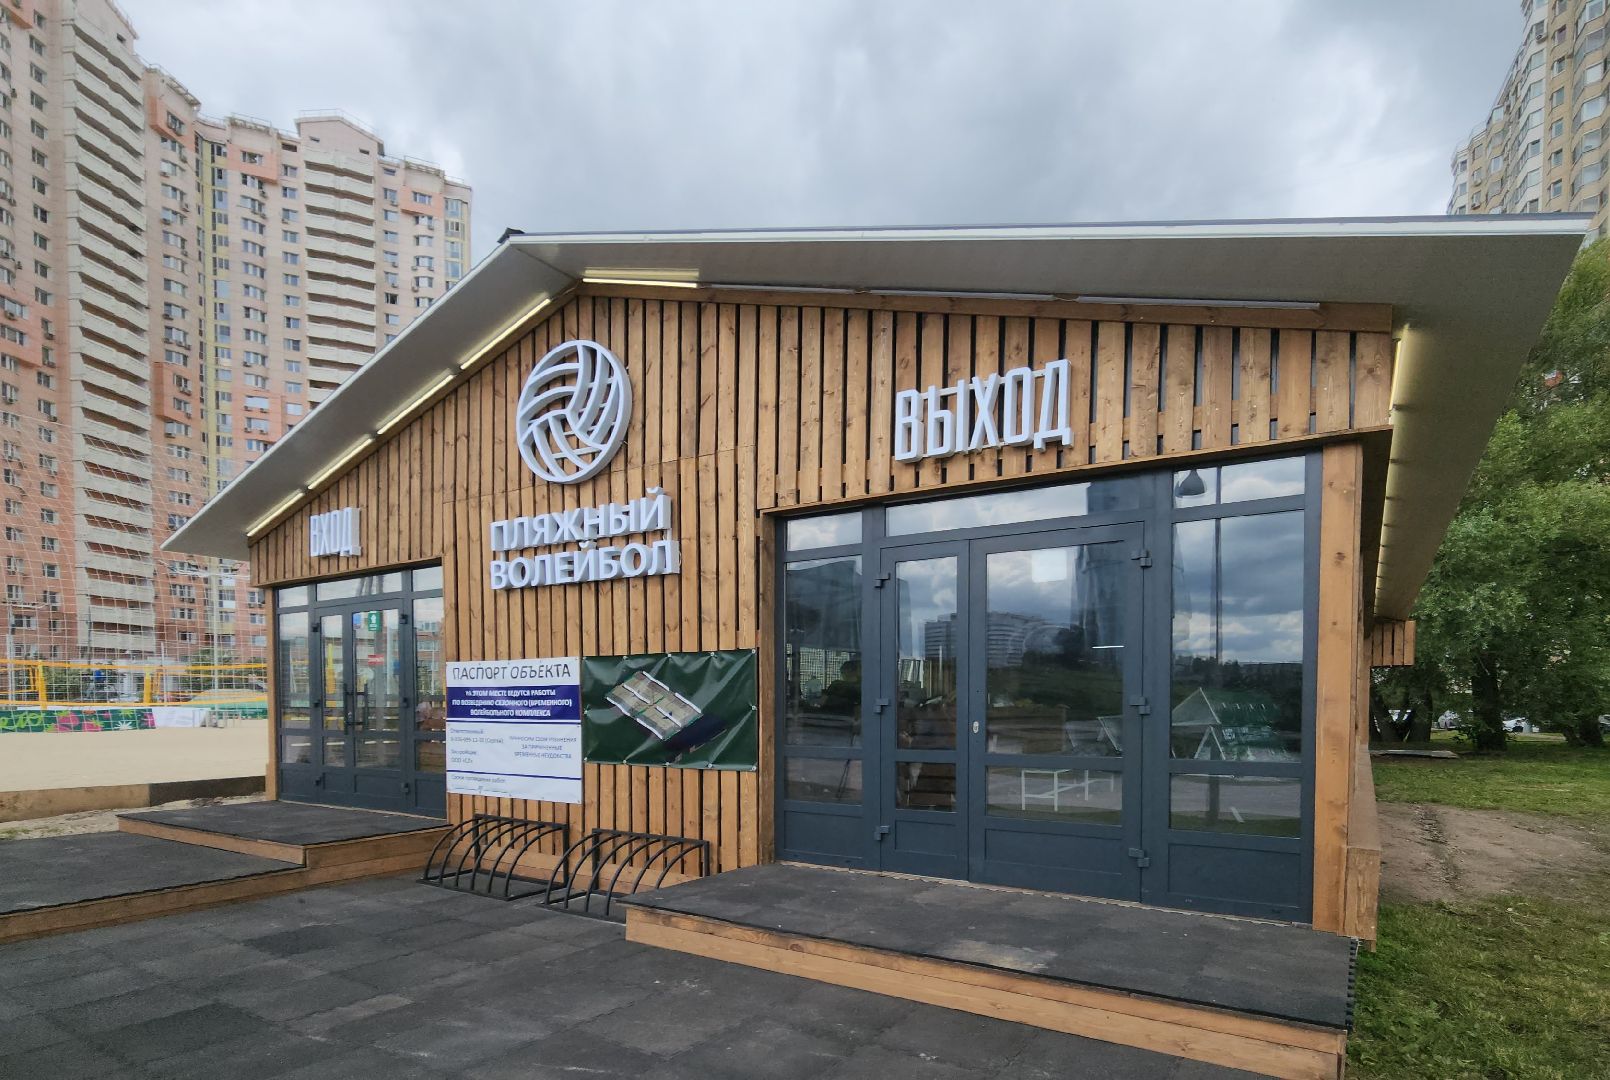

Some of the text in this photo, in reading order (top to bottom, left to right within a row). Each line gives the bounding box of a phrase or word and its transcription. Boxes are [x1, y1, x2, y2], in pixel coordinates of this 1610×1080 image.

[895, 359, 1074, 464] ВЫХОД
[310, 506, 361, 557] ВХОД
[490, 486, 672, 551] ПЛЯЖНЫЙ
[490, 541, 680, 590] ВОЛЕЙБОЛ
[452, 663, 571, 680] ПАСПОРТ ОБЪЕКТА
